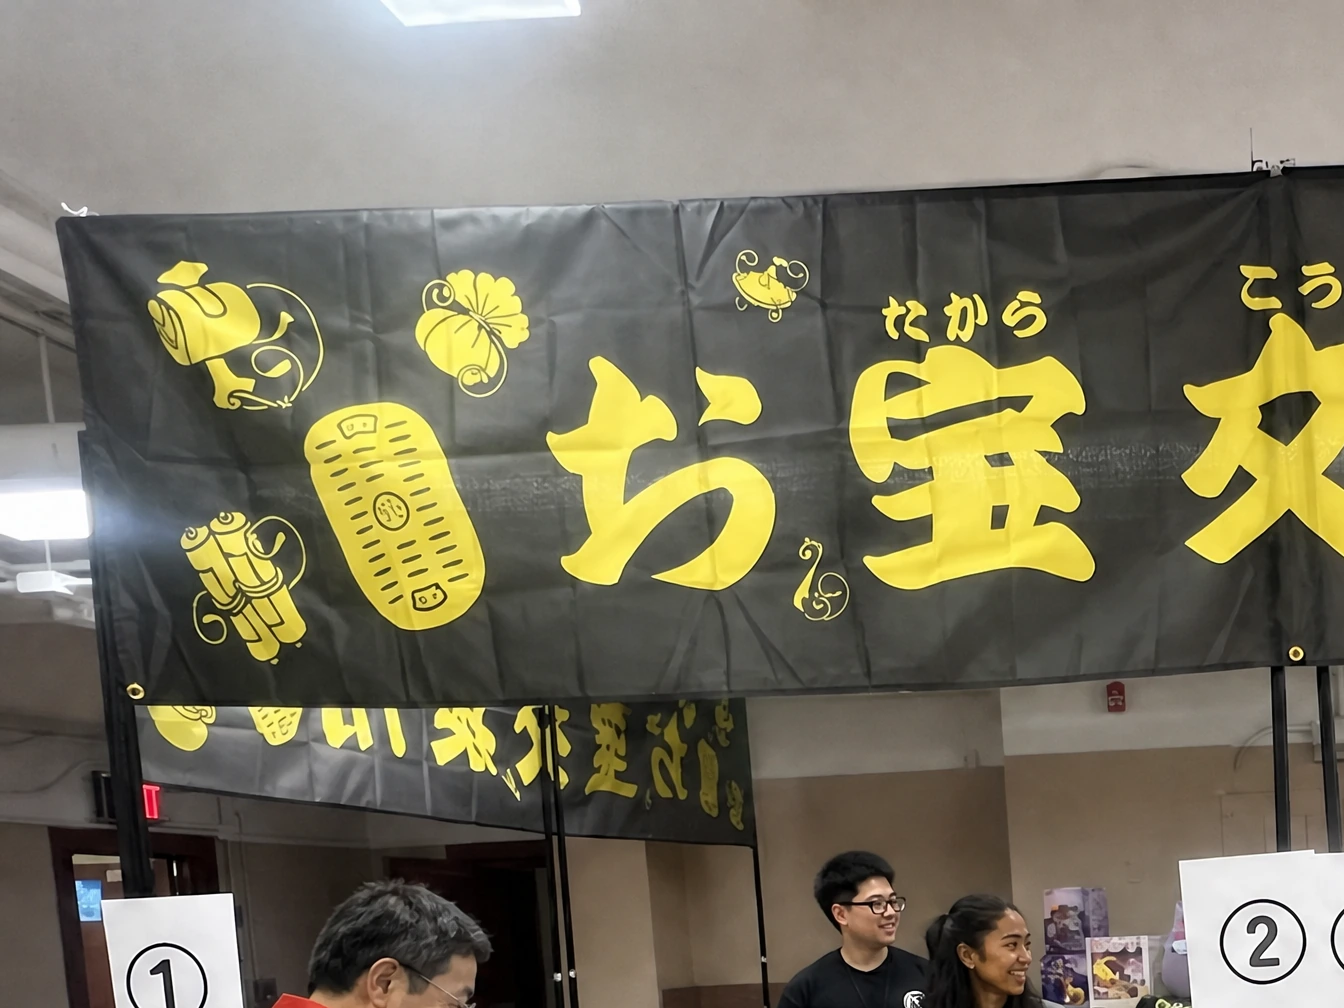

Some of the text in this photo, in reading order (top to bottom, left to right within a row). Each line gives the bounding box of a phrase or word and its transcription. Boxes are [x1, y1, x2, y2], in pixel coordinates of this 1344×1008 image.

[882, 291, 1048, 342] たから
[1240, 262, 1343, 311] こう
